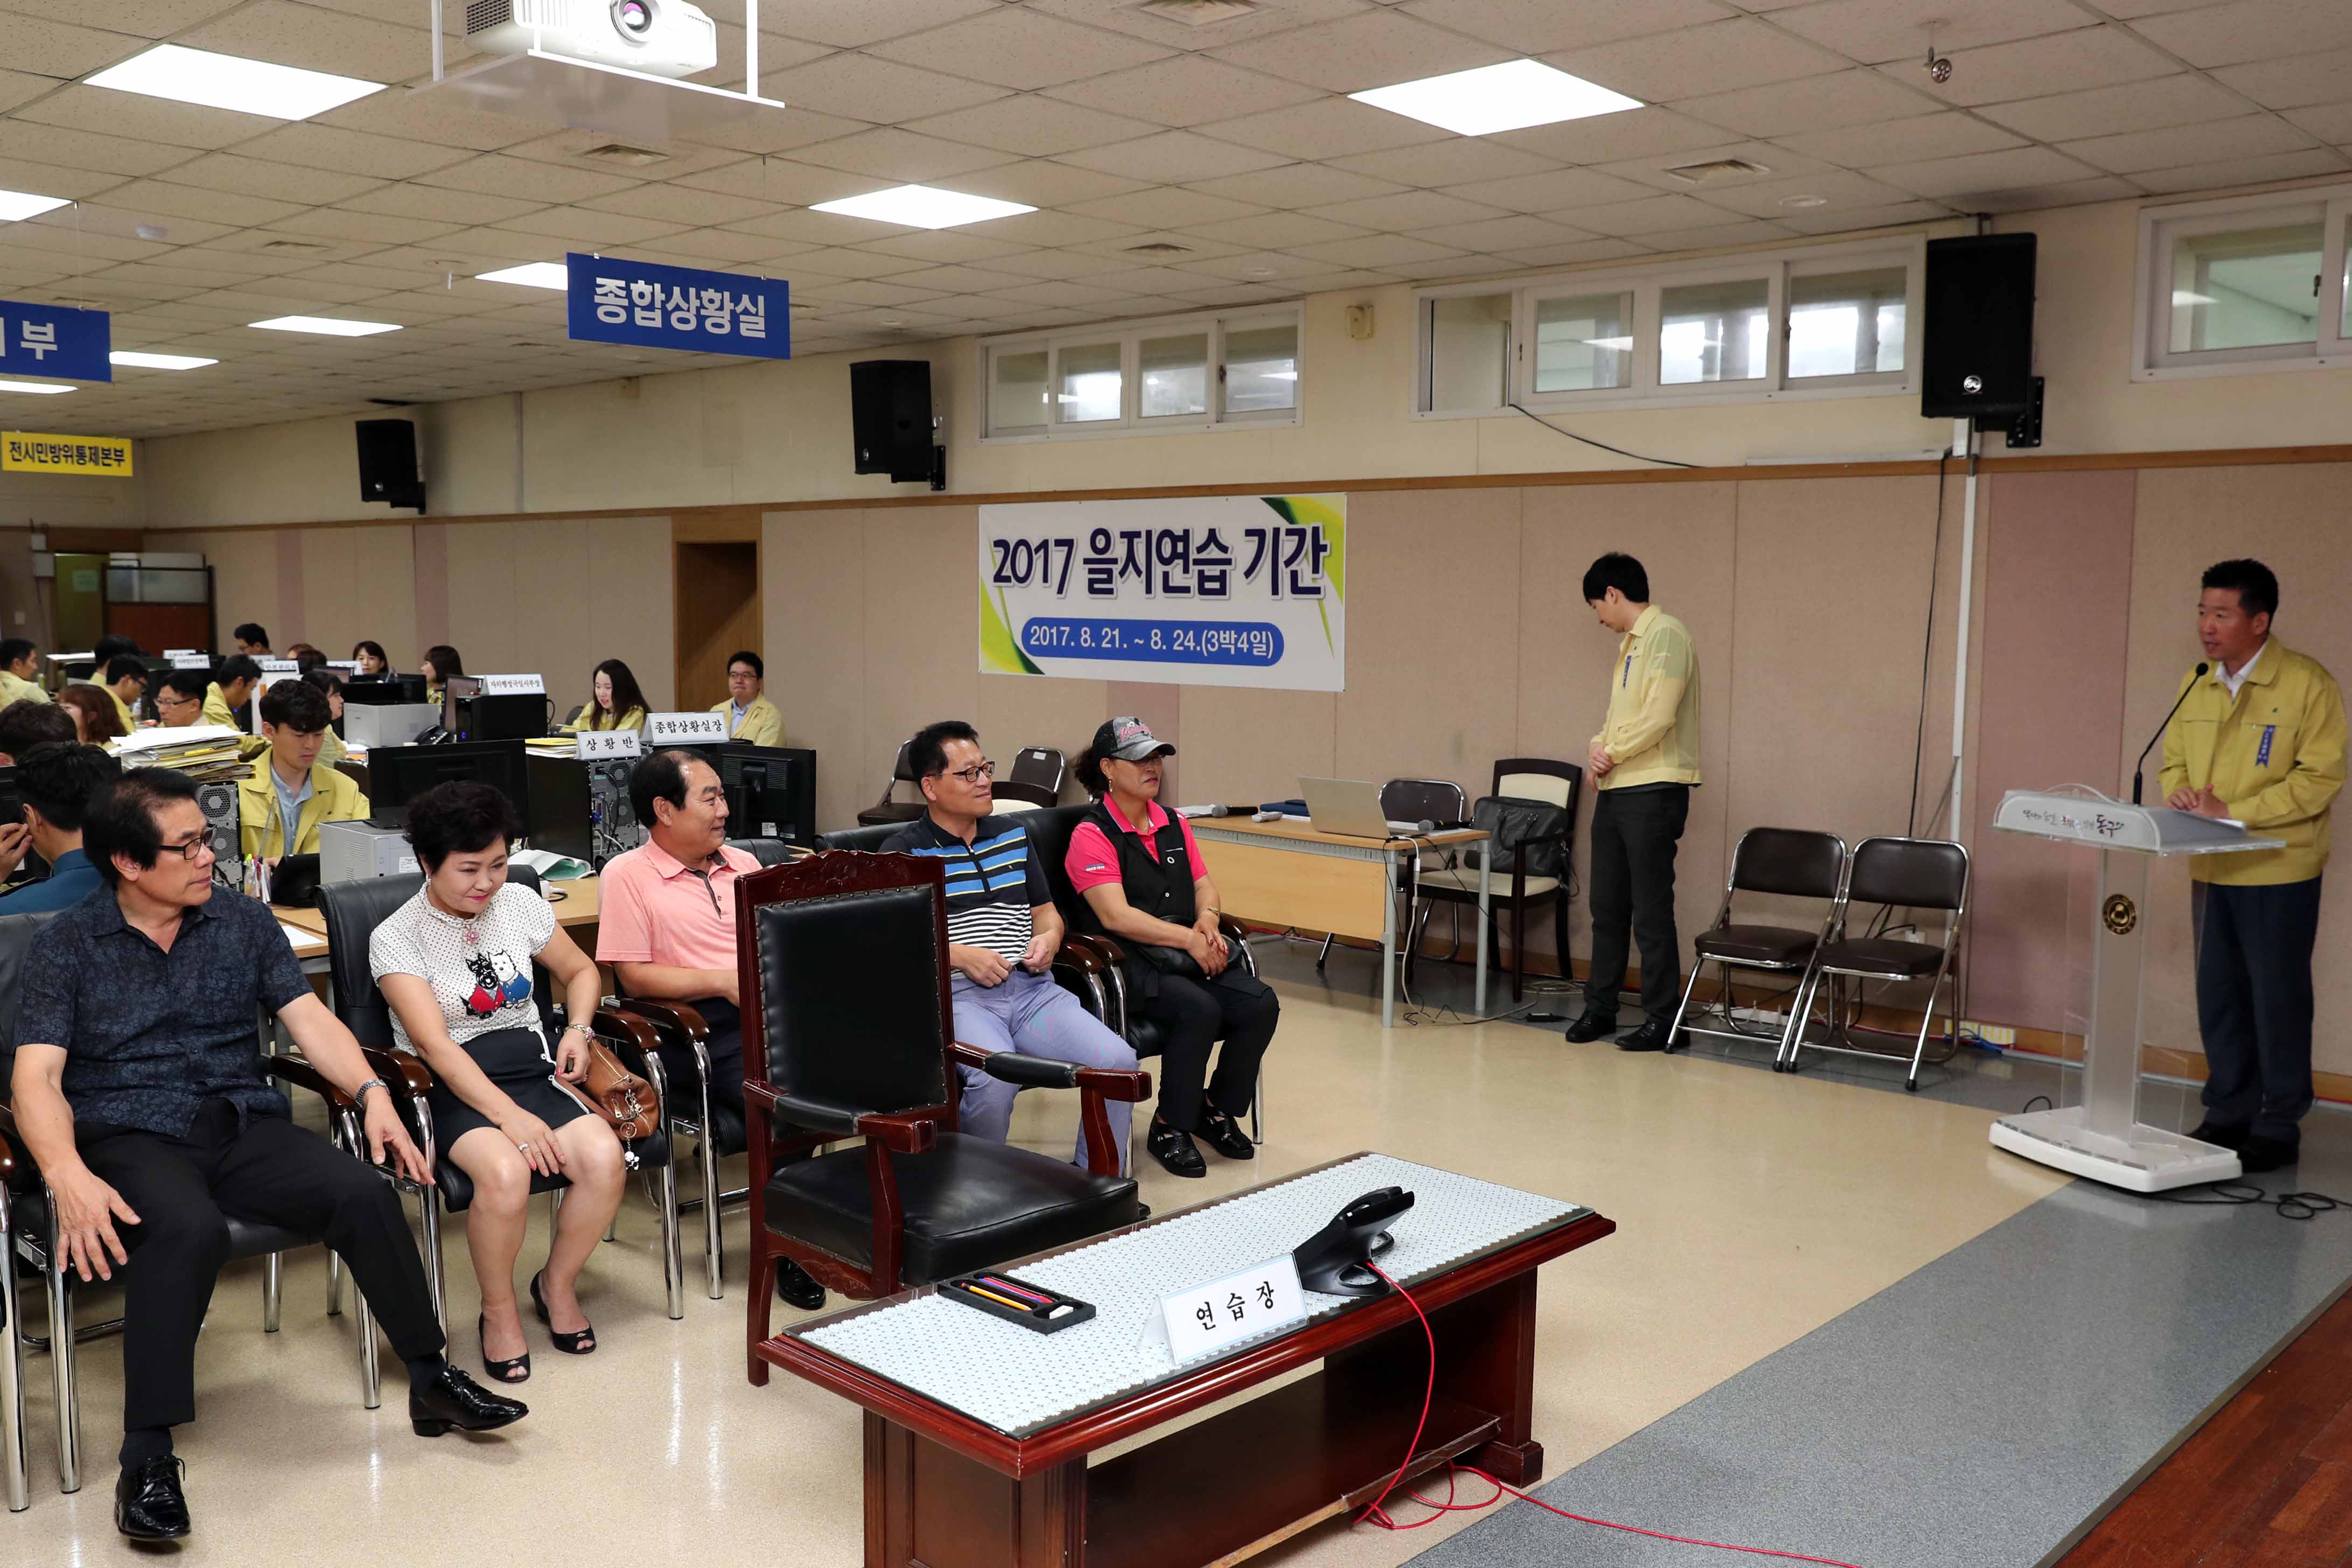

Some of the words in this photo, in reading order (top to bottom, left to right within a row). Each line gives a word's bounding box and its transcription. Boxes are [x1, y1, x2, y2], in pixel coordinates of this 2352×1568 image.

[594, 277, 766, 339] 종합상황실
[9, 440, 125, 467] 전시민방위통제본부
[993, 538, 1075, 595] 2017
[1082, 527, 1233, 596] 을지연습
[1243, 526, 1328, 596] 기간
[1030, 625, 1075, 647] 2017.
[1080, 626, 1096, 648] 8.
[1101, 627, 1128, 649] 21.
[1150, 628, 1167, 650] 8.
[655, 719, 723, 734] 종합상황실장
